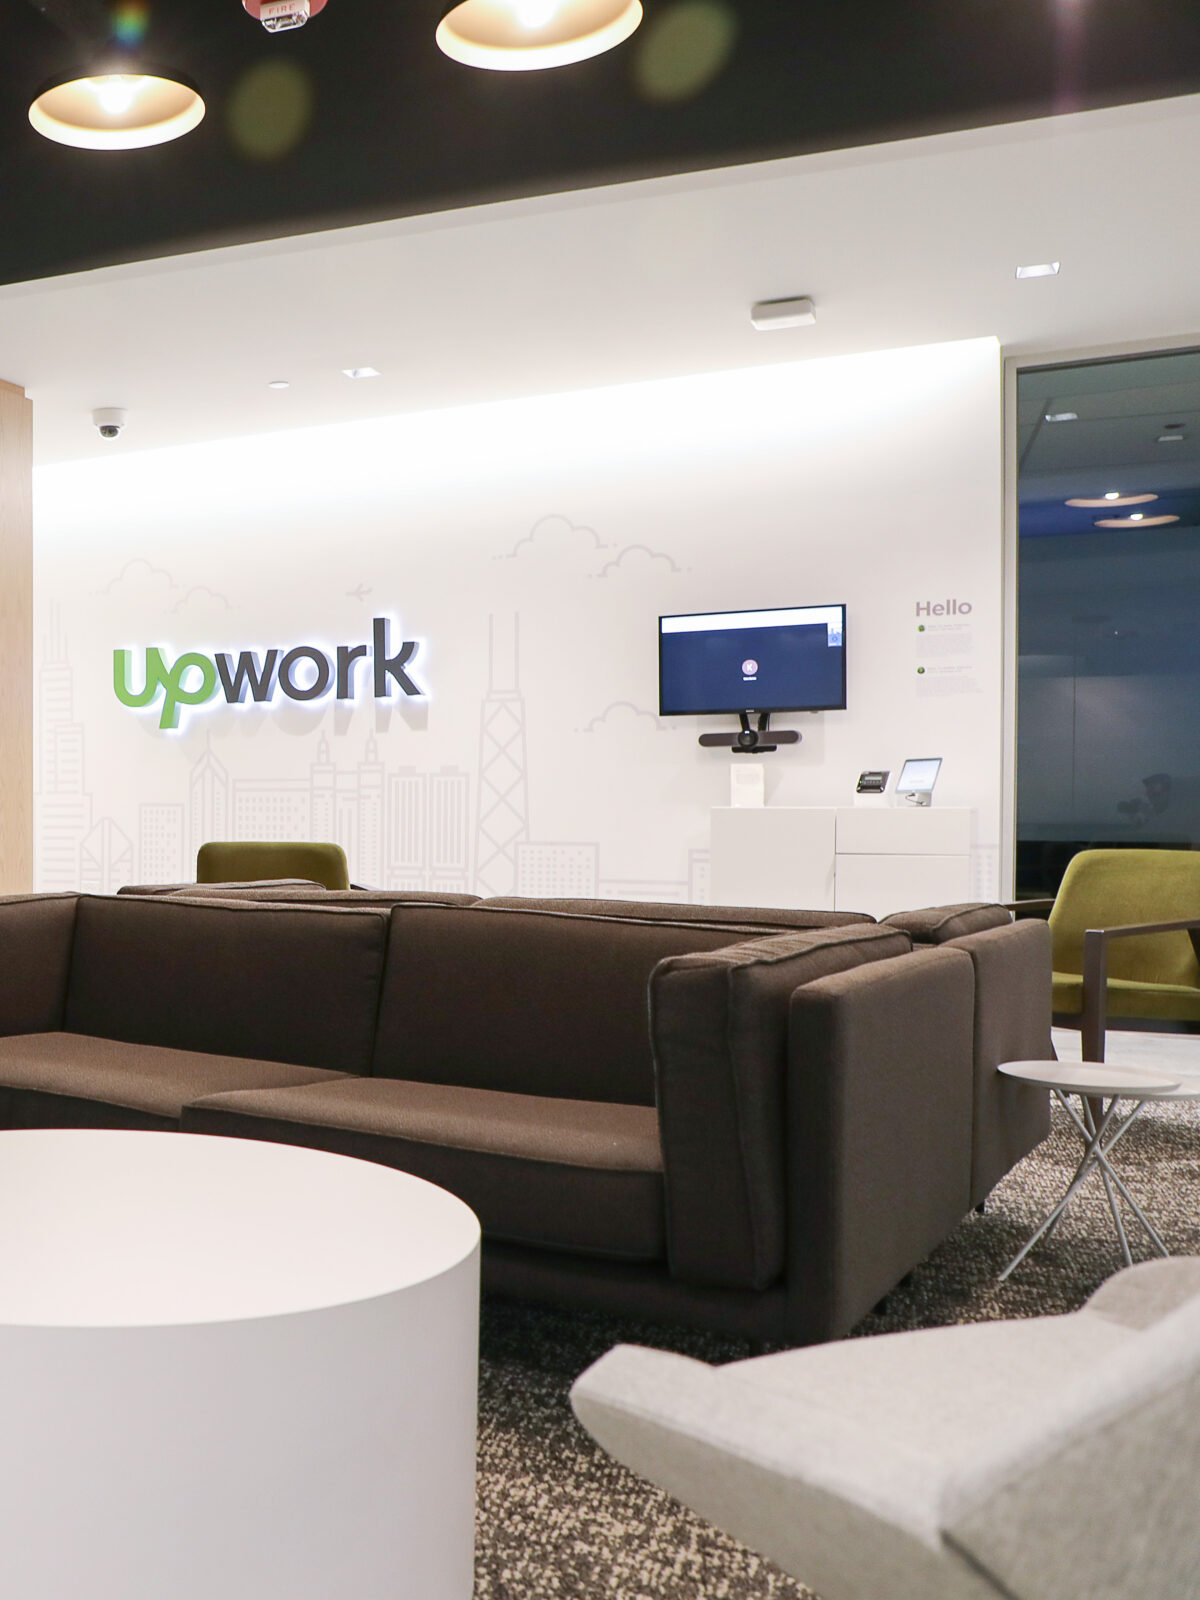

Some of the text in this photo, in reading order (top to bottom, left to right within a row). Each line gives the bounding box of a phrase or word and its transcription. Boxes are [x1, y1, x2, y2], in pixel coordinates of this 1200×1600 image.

[268, 3, 296, 16] FIRE
[916, 599, 972, 617] Hello
[113, 617, 424, 729] upwork
